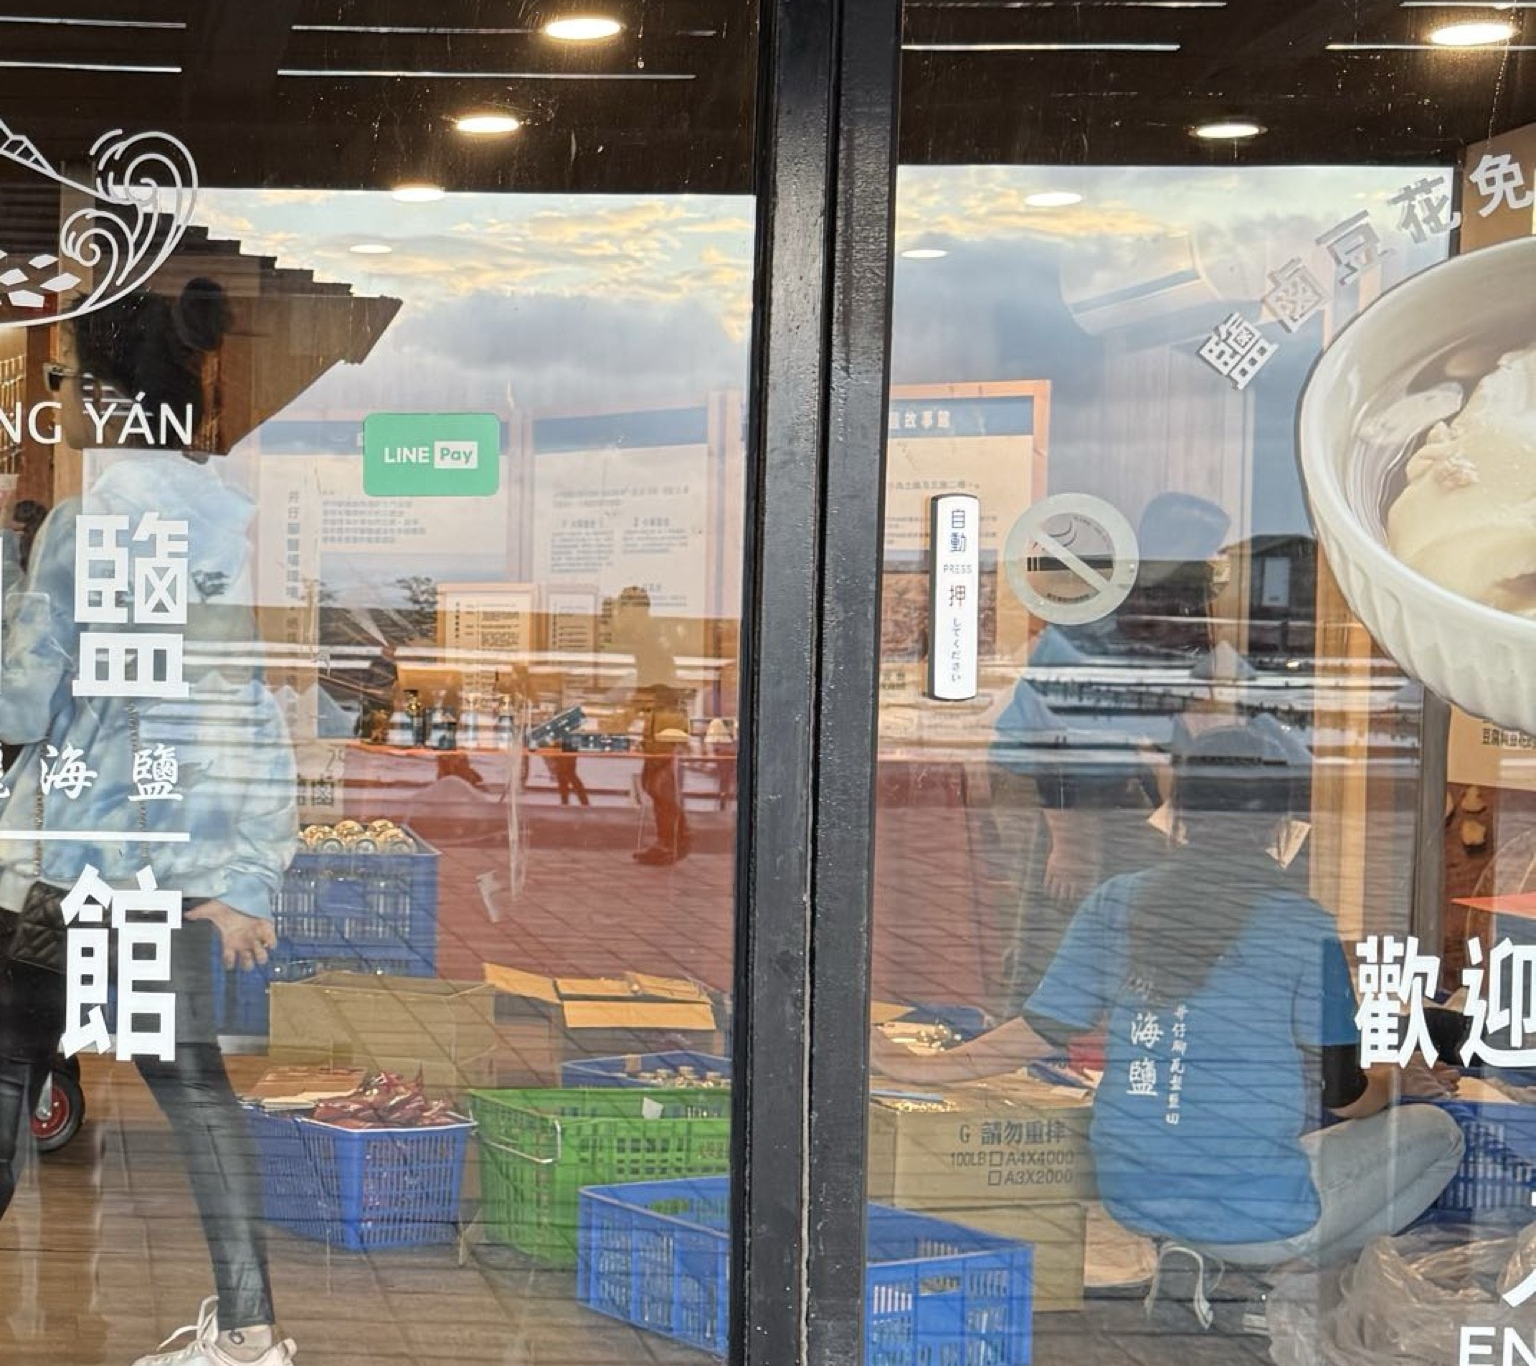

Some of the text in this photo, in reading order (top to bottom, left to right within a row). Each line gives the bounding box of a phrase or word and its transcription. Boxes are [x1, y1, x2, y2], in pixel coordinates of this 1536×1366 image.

[84, 391, 193, 446] YÁN
[383, 446, 473, 464] LINE Pay
[950, 508, 967, 552] 自動
